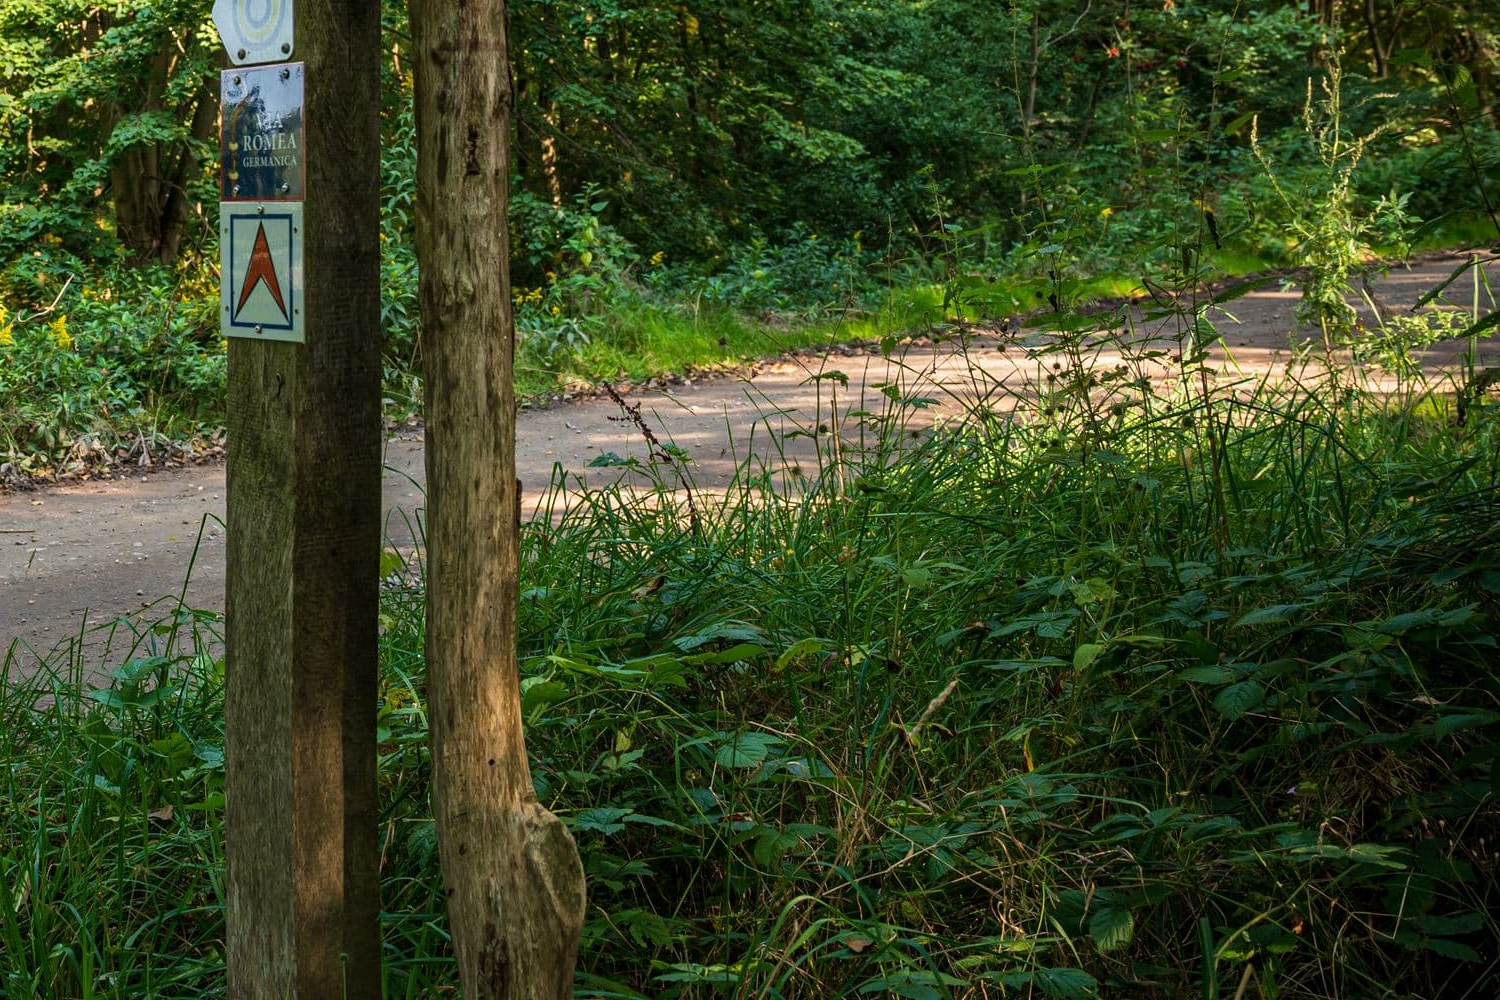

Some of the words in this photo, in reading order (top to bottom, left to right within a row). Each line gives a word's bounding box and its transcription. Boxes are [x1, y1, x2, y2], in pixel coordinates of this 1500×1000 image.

[256, 112, 284, 129] VIA
[243, 132, 297, 151] ROMEA
[242, 155, 297, 167] GERMANICA
